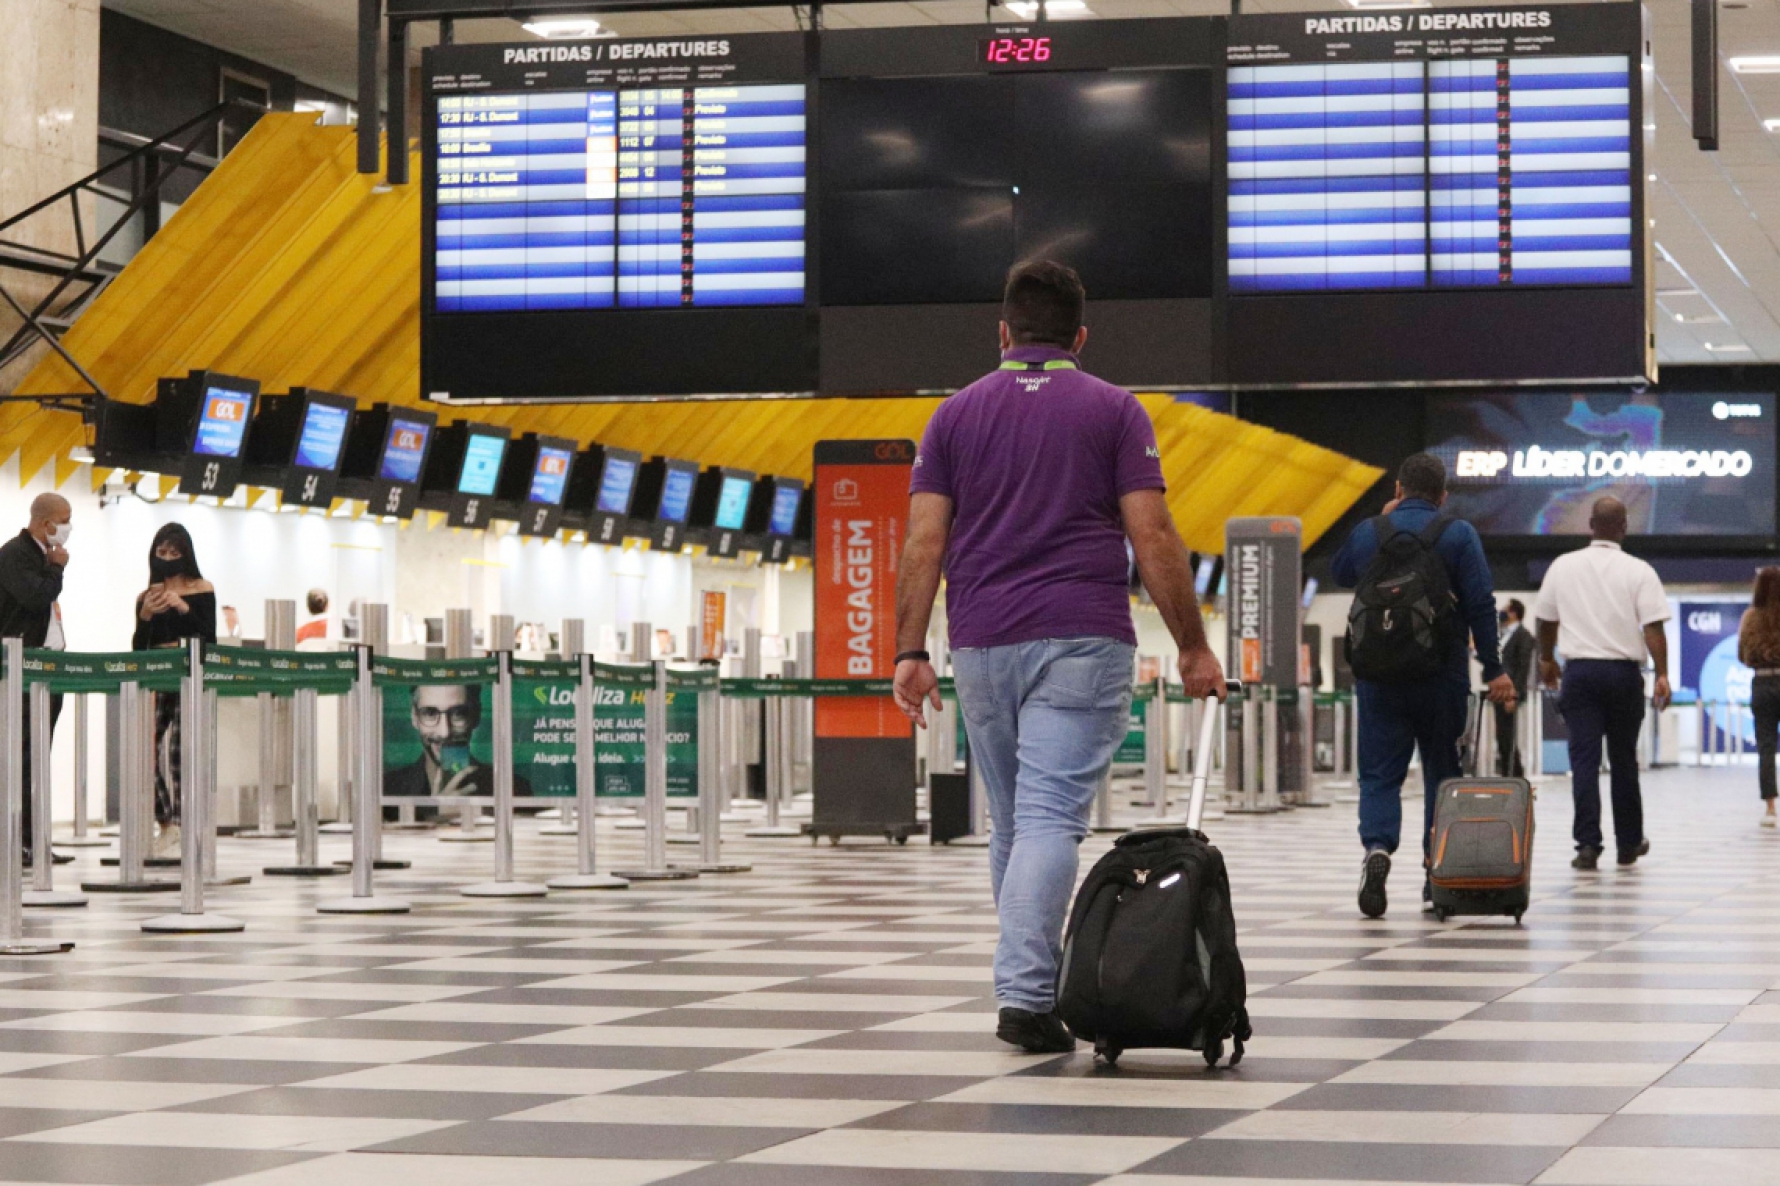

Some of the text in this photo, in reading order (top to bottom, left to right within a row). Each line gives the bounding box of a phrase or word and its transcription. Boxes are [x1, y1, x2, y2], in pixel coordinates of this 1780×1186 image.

[1305, 11, 1551, 34] PARTIDAS / DEPARTURES
[503, 40, 730, 64] PARTIDAS / DEPARTURES
[987, 38, 1051, 61] 12:26
[216, 402, 235, 419] GOL
[1457, 451, 1507, 476] ERP
[1513, 444, 1586, 476] LÍDER
[202, 462, 220, 490] 53
[302, 474, 319, 501] 54
[386, 487, 402, 512] 55
[847, 519, 873, 675] BAGAGEM
[1241, 544, 1260, 639] PREMIUM
[1688, 612, 1721, 632] CGH
[534, 717, 547, 729] JÁ
[534, 733, 560, 743] PODE
[563, 733, 577, 743] SE
[595, 733, 637, 743] MELHOR
[534, 753, 570, 766] Alugue
[598, 752, 626, 764] ideia.
